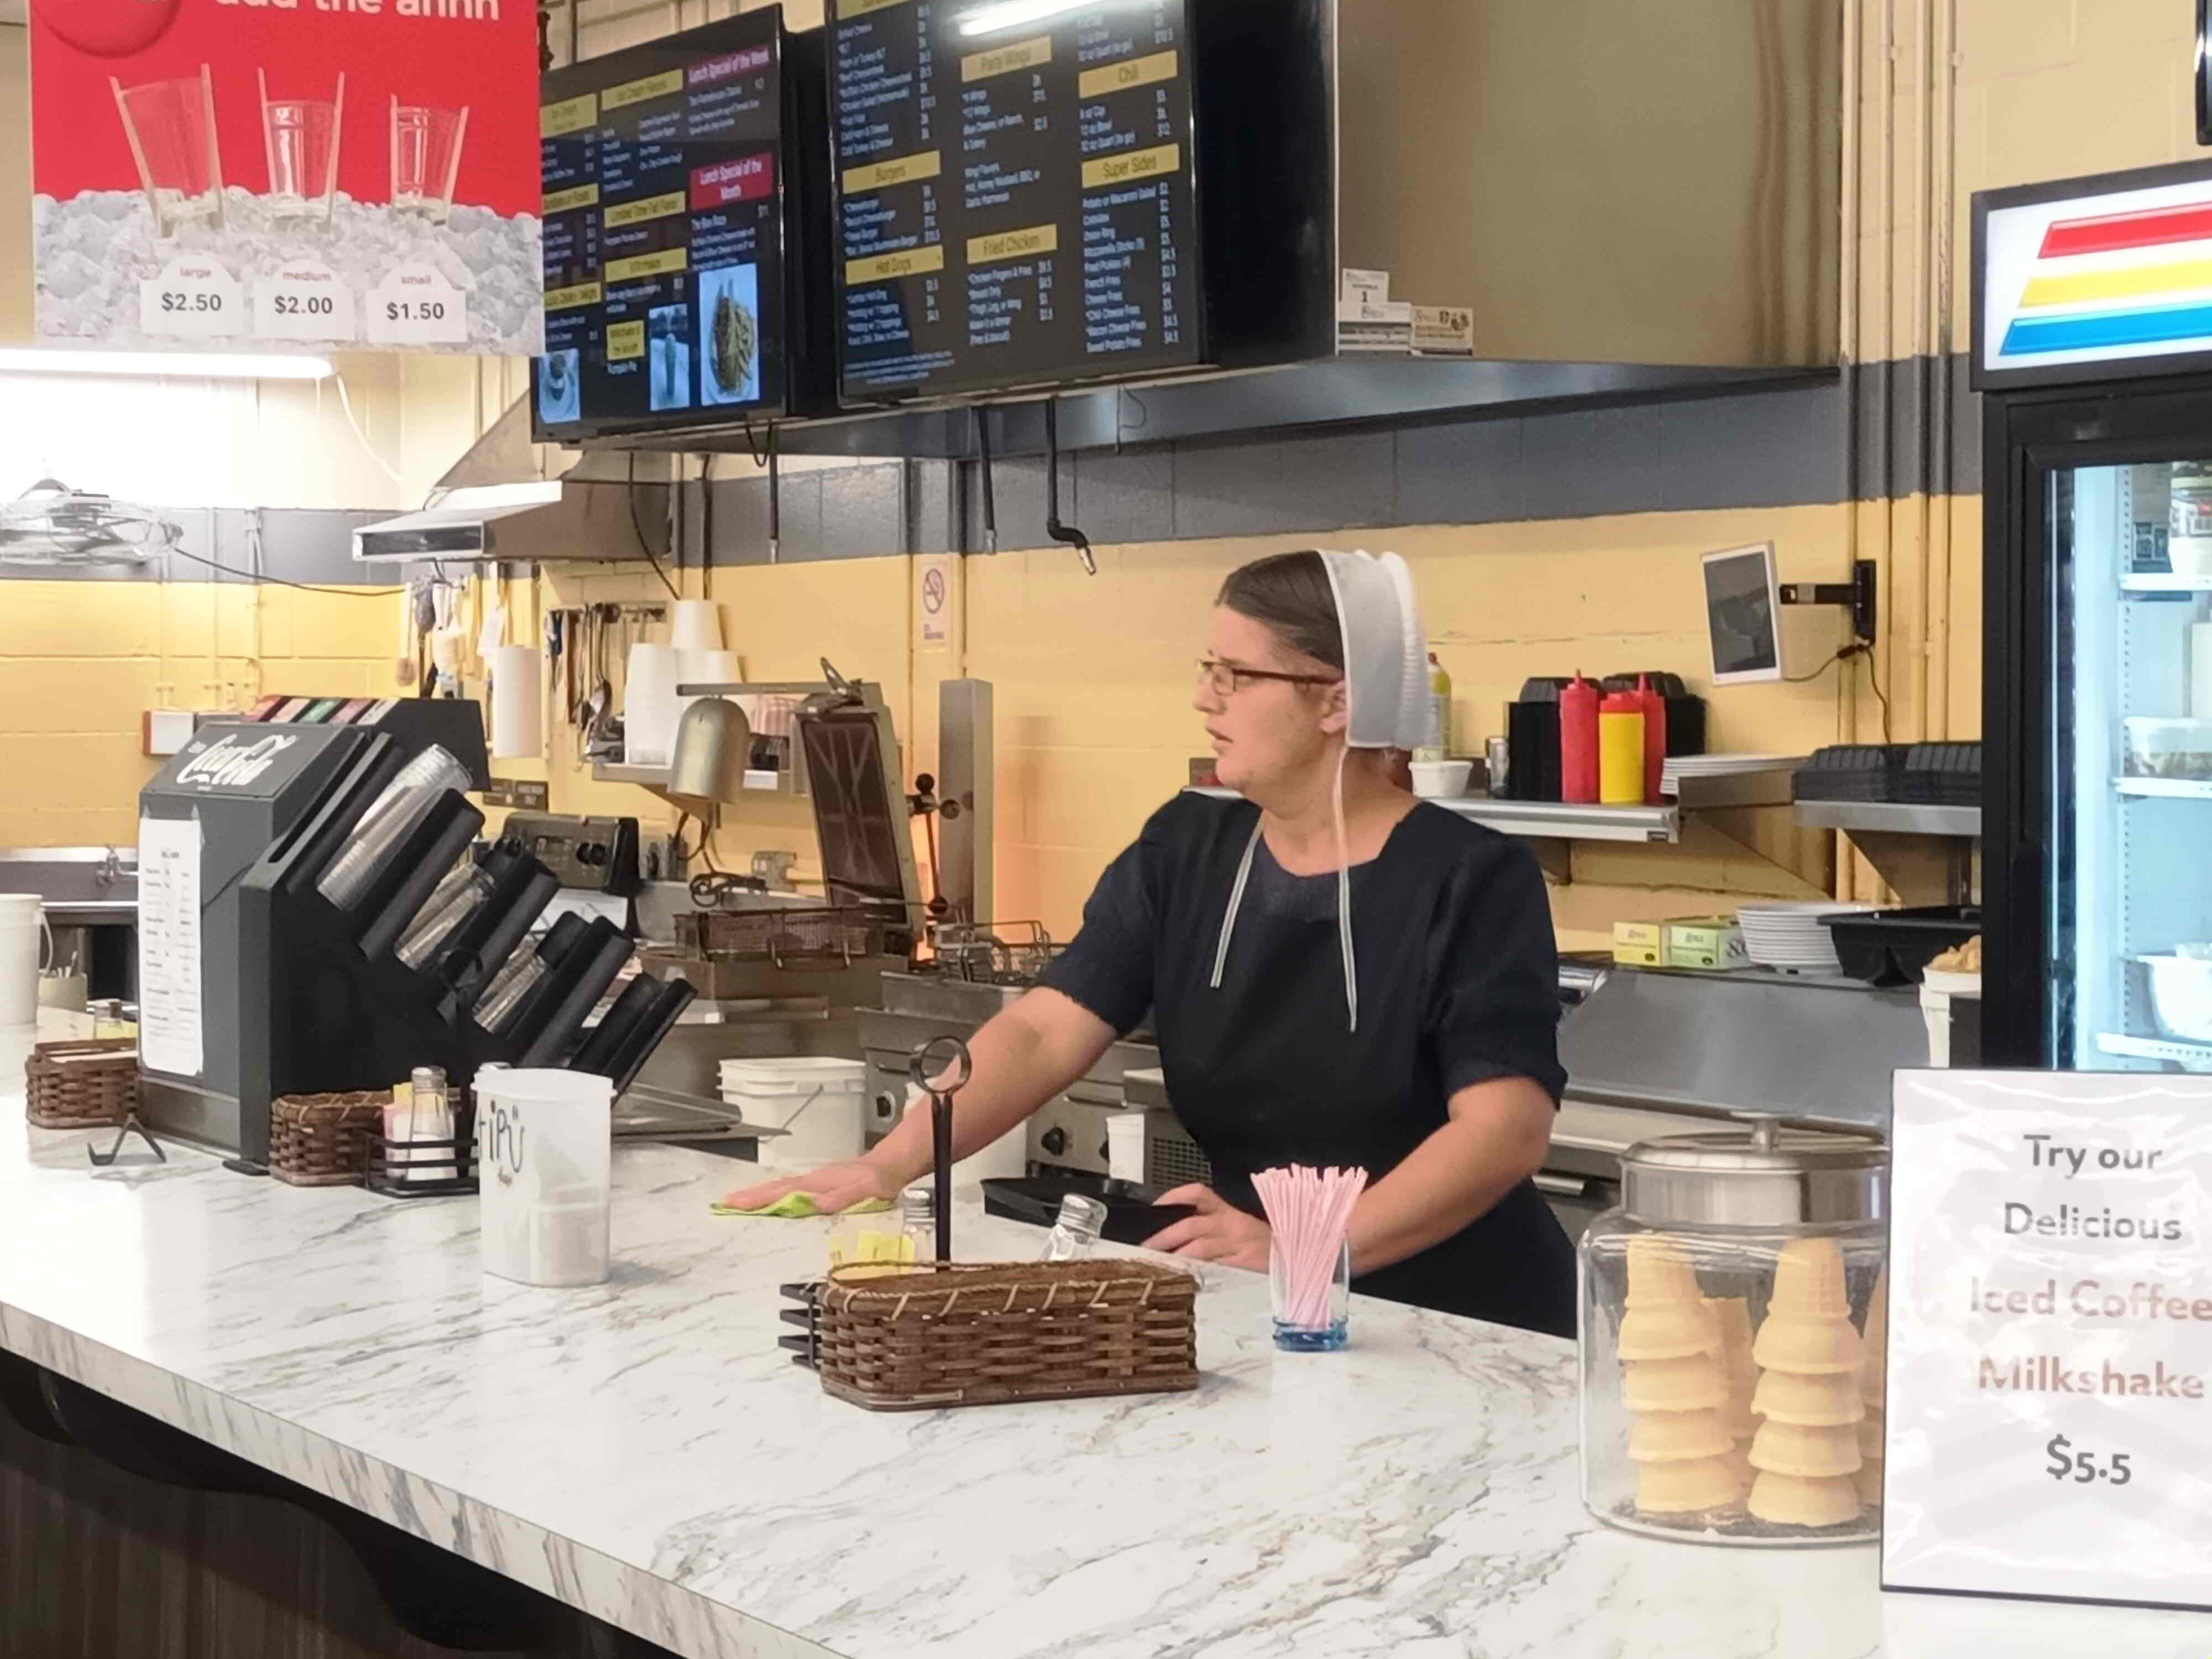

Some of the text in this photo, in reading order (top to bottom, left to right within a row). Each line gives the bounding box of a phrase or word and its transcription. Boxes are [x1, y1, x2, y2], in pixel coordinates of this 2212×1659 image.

[161, 293, 445, 320] $2.50 $2.00 $1.50
[2023, 1134, 2163, 1180] Try our
[2004, 1201, 2182, 1241] Delicious
[1970, 1275, 2212, 1322] Iced Coffee
[1979, 1356, 2205, 1399] Milkshake
[2046, 1433, 2132, 1485] $5.5
